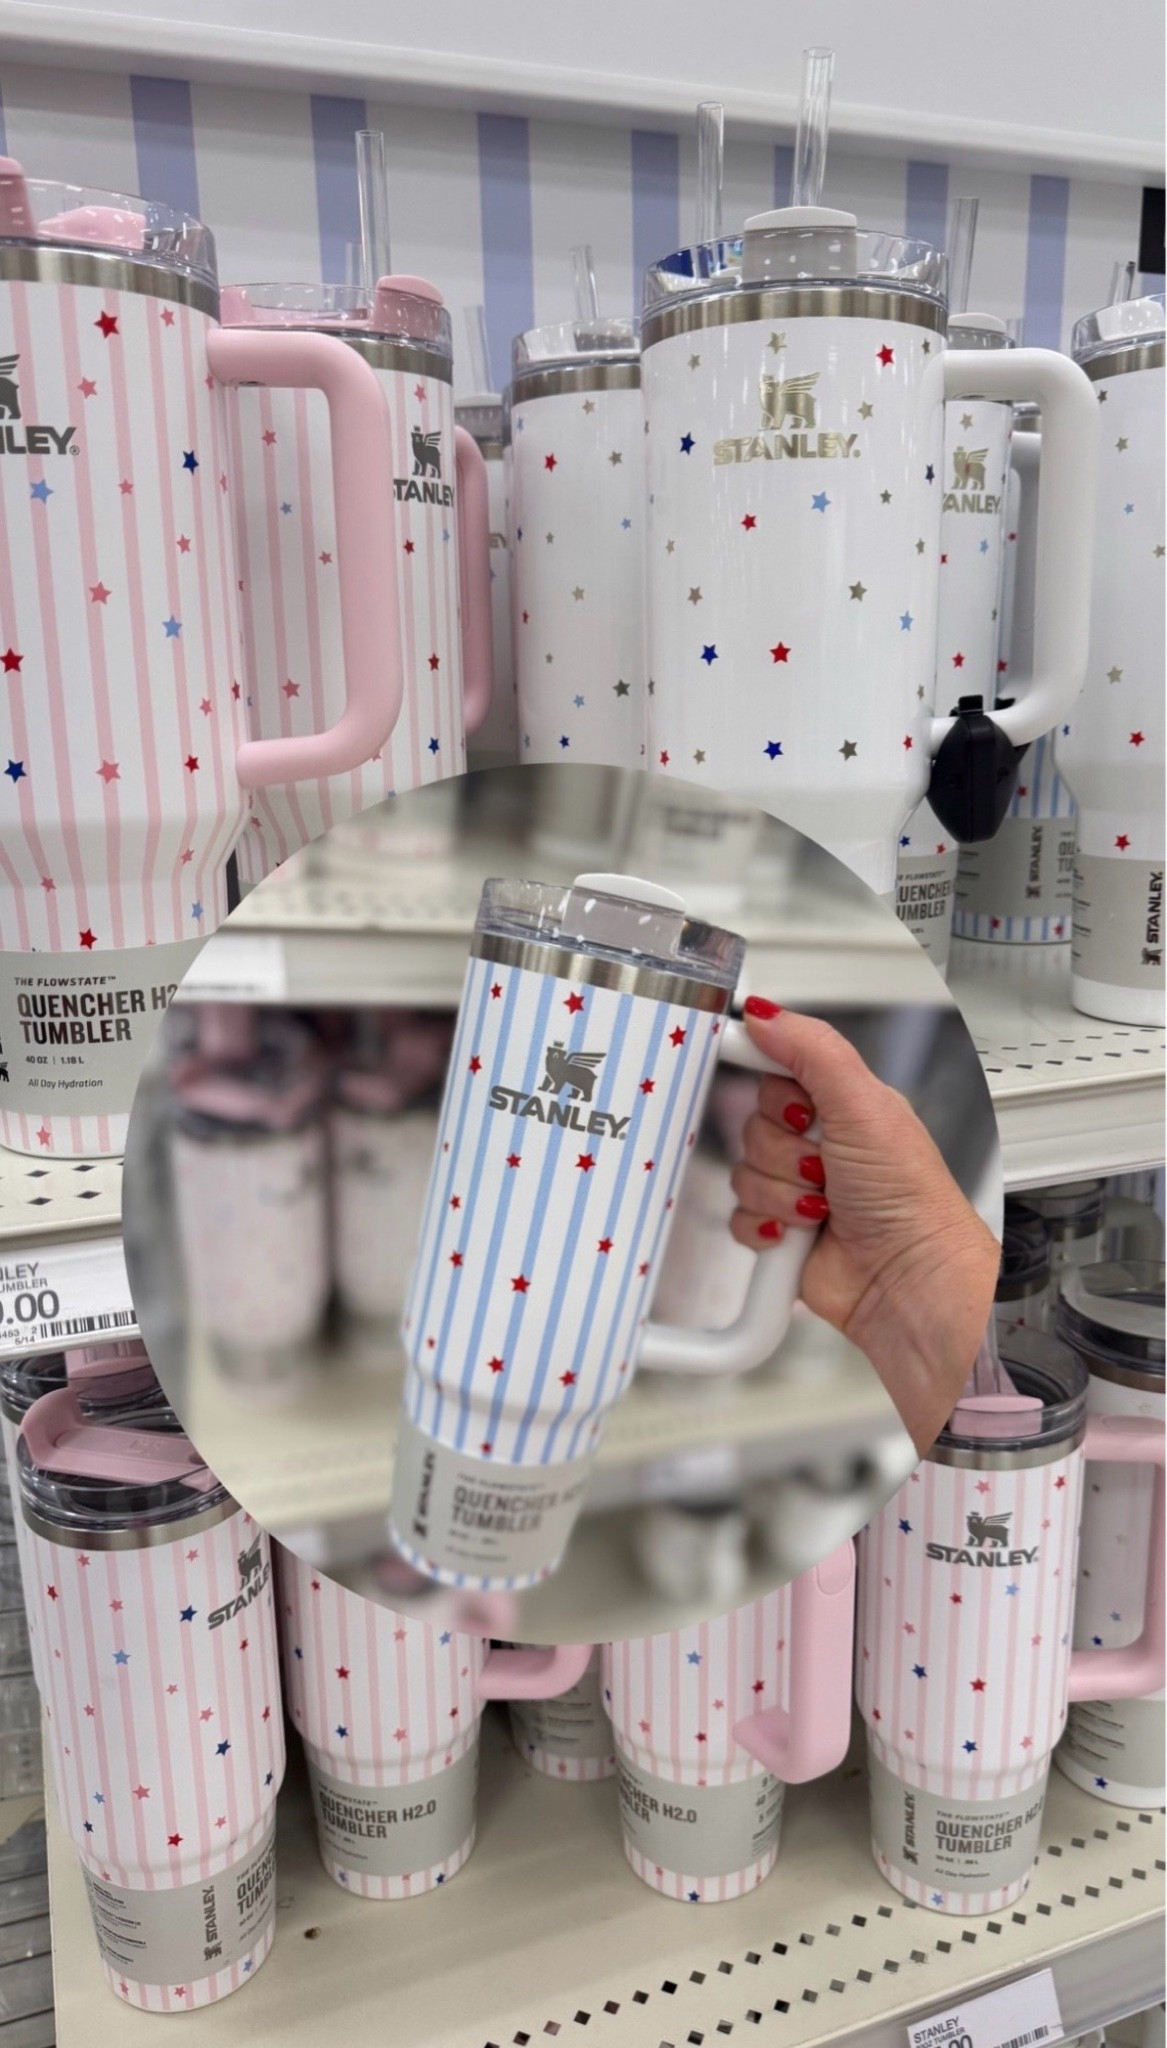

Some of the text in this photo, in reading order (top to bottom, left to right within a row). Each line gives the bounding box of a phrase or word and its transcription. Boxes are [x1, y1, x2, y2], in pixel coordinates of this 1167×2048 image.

[392, 478, 454, 507] TANLEY
[14, 977, 34, 987] THE
[17, 989, 146, 1018] QUENCHER
[19, 1018, 132, 1045] TUMBLER
[37, 1056, 48, 1065] OZ
[28, 1078, 103, 1090] All Day Hydration
[0, 1262, 39, 1282] LEY
[0, 1289, 60, 1325] .00
[402, 1799, 437, 1822] H2.0
[662, 1802, 697, 1824] H2.0
[935, 1815, 1023, 1839] QUENCHER
[935, 1834, 1012, 1854] TUMBLER
[913, 2015, 960, 2044] STANLEY
